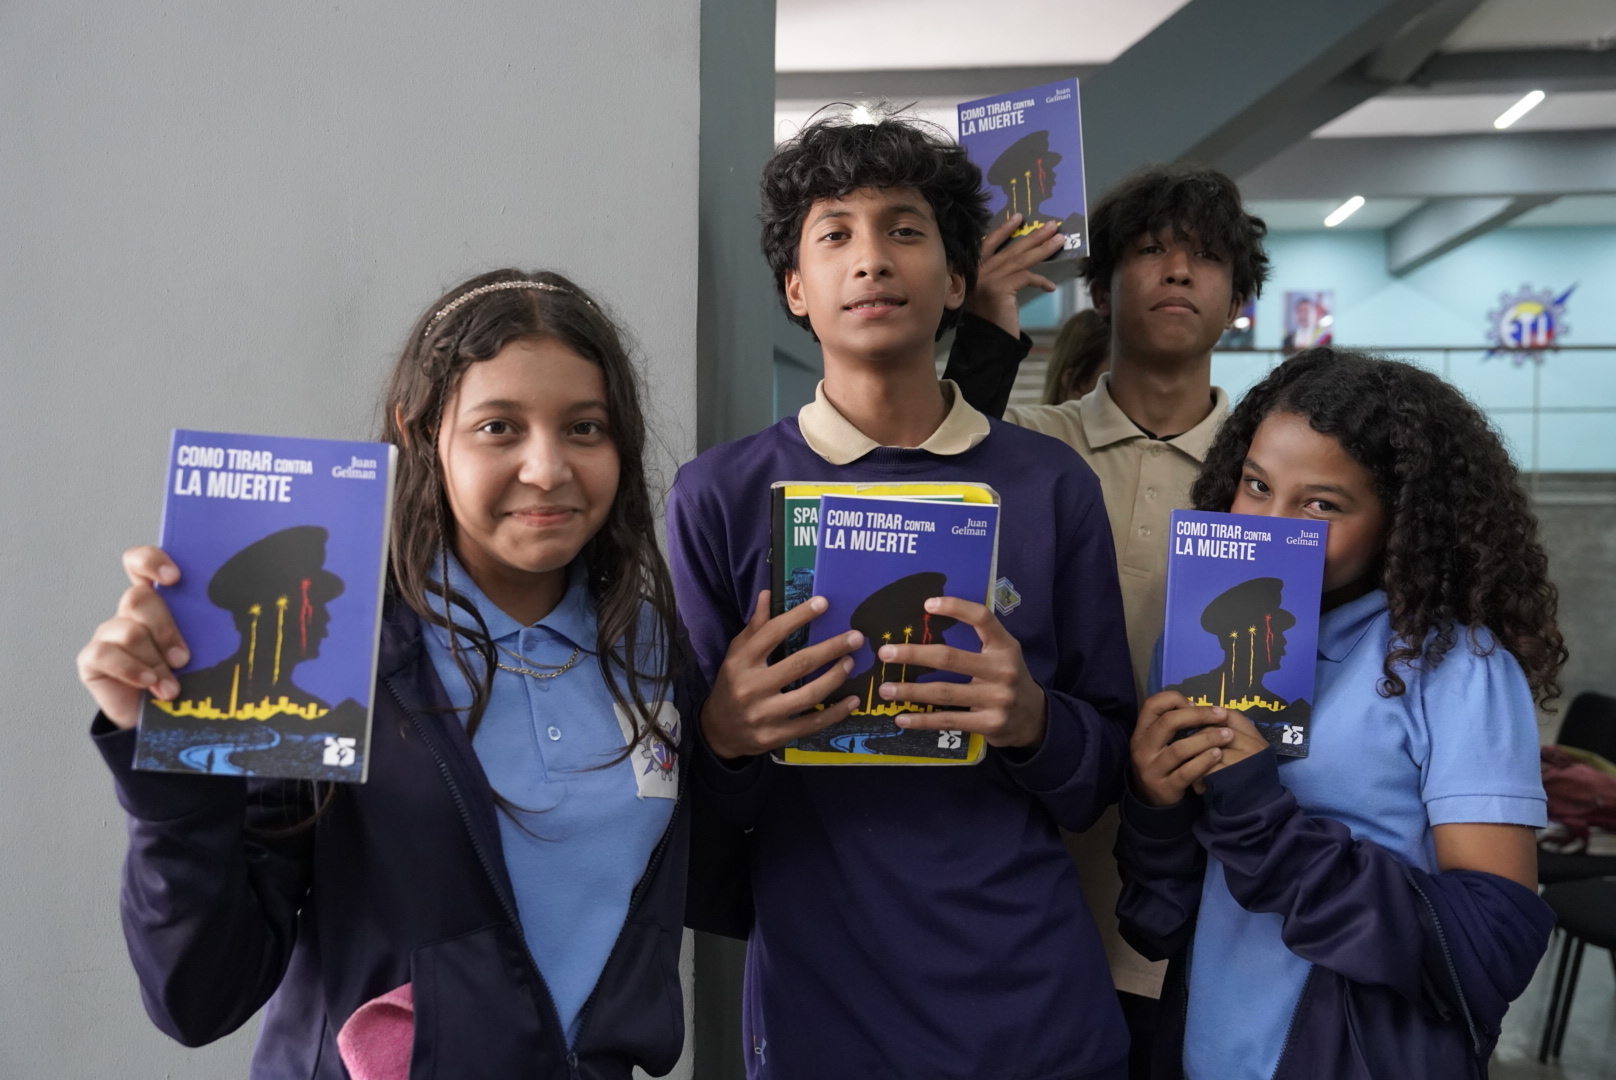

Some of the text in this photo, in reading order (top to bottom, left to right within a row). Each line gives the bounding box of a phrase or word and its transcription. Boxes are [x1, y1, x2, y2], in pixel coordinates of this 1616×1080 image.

[1046, 93, 1071, 103] Gelman
[1056, 88, 1071, 96] Juan
[961, 99, 1035, 121] COMO TIRAR CONTRA
[961, 110, 1025, 136] LA MUERTE
[177, 445, 313, 475] COMO TIRAR CONTRA
[351, 456, 377, 469] Juan
[331, 466, 376, 480] Gelman
[174, 468, 293, 502] LA MUERTE
[827, 510, 935, 532] COMO TIRAR CONTRA
[967, 518, 987, 529] Juan
[951, 526, 986, 536] Gelman
[1176, 521, 1272, 542] COMO TIRAR CONTRA
[1300, 530, 1319, 539] Juan
[825, 528, 918, 554] LA MUERTE
[1175, 537, 1257, 561] LA MUERTE
[1286, 536, 1319, 546] Gelman
